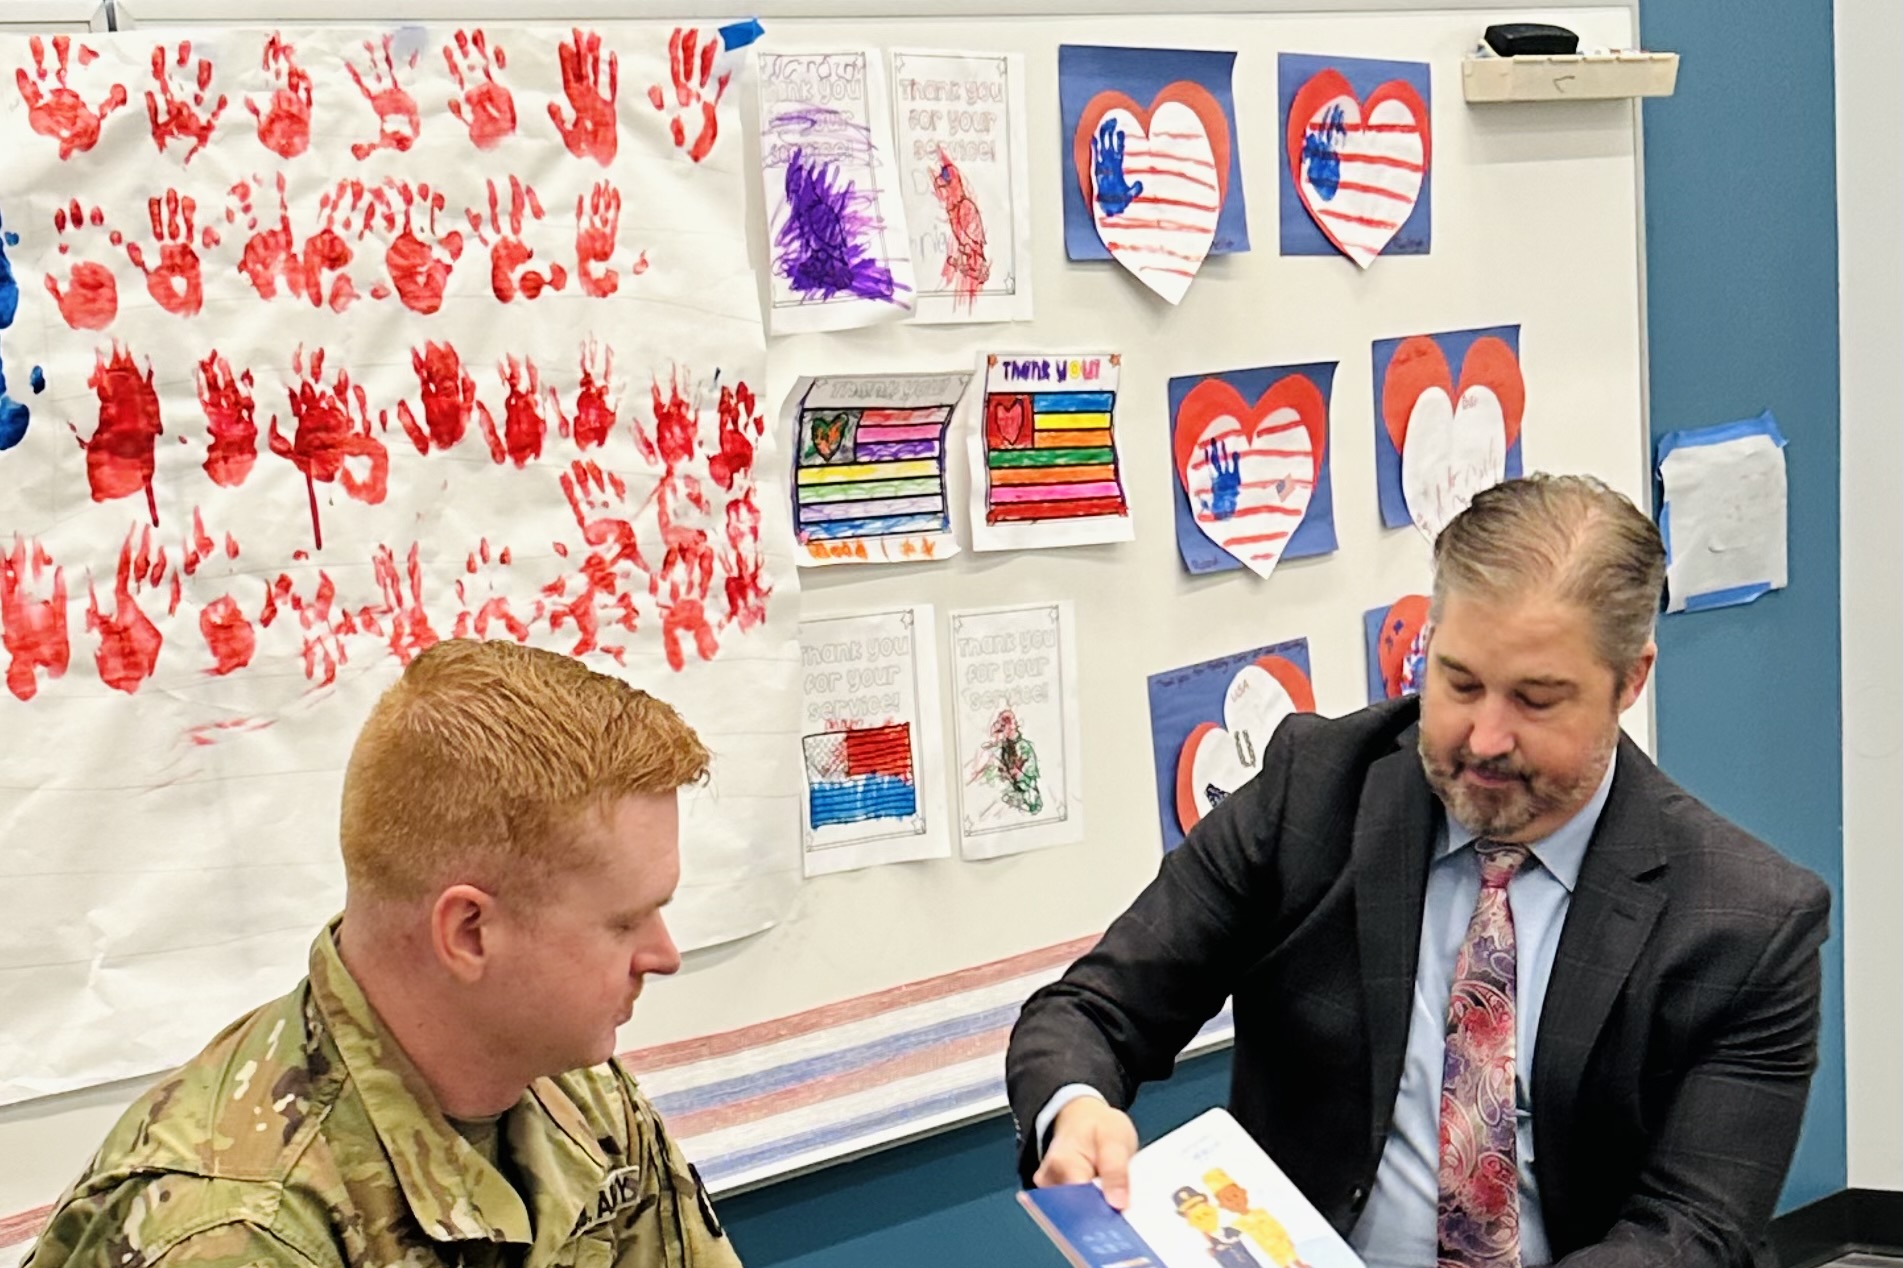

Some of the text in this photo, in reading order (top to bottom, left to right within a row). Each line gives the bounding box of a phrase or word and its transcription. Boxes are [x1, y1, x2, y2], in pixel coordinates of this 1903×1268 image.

[965, 80, 1004, 106] you
[947, 109, 997, 136] your
[867, 635, 909, 662] you
[1019, 629, 1056, 654] you
[804, 664, 901, 695] for your
[1003, 657, 1050, 683] your
